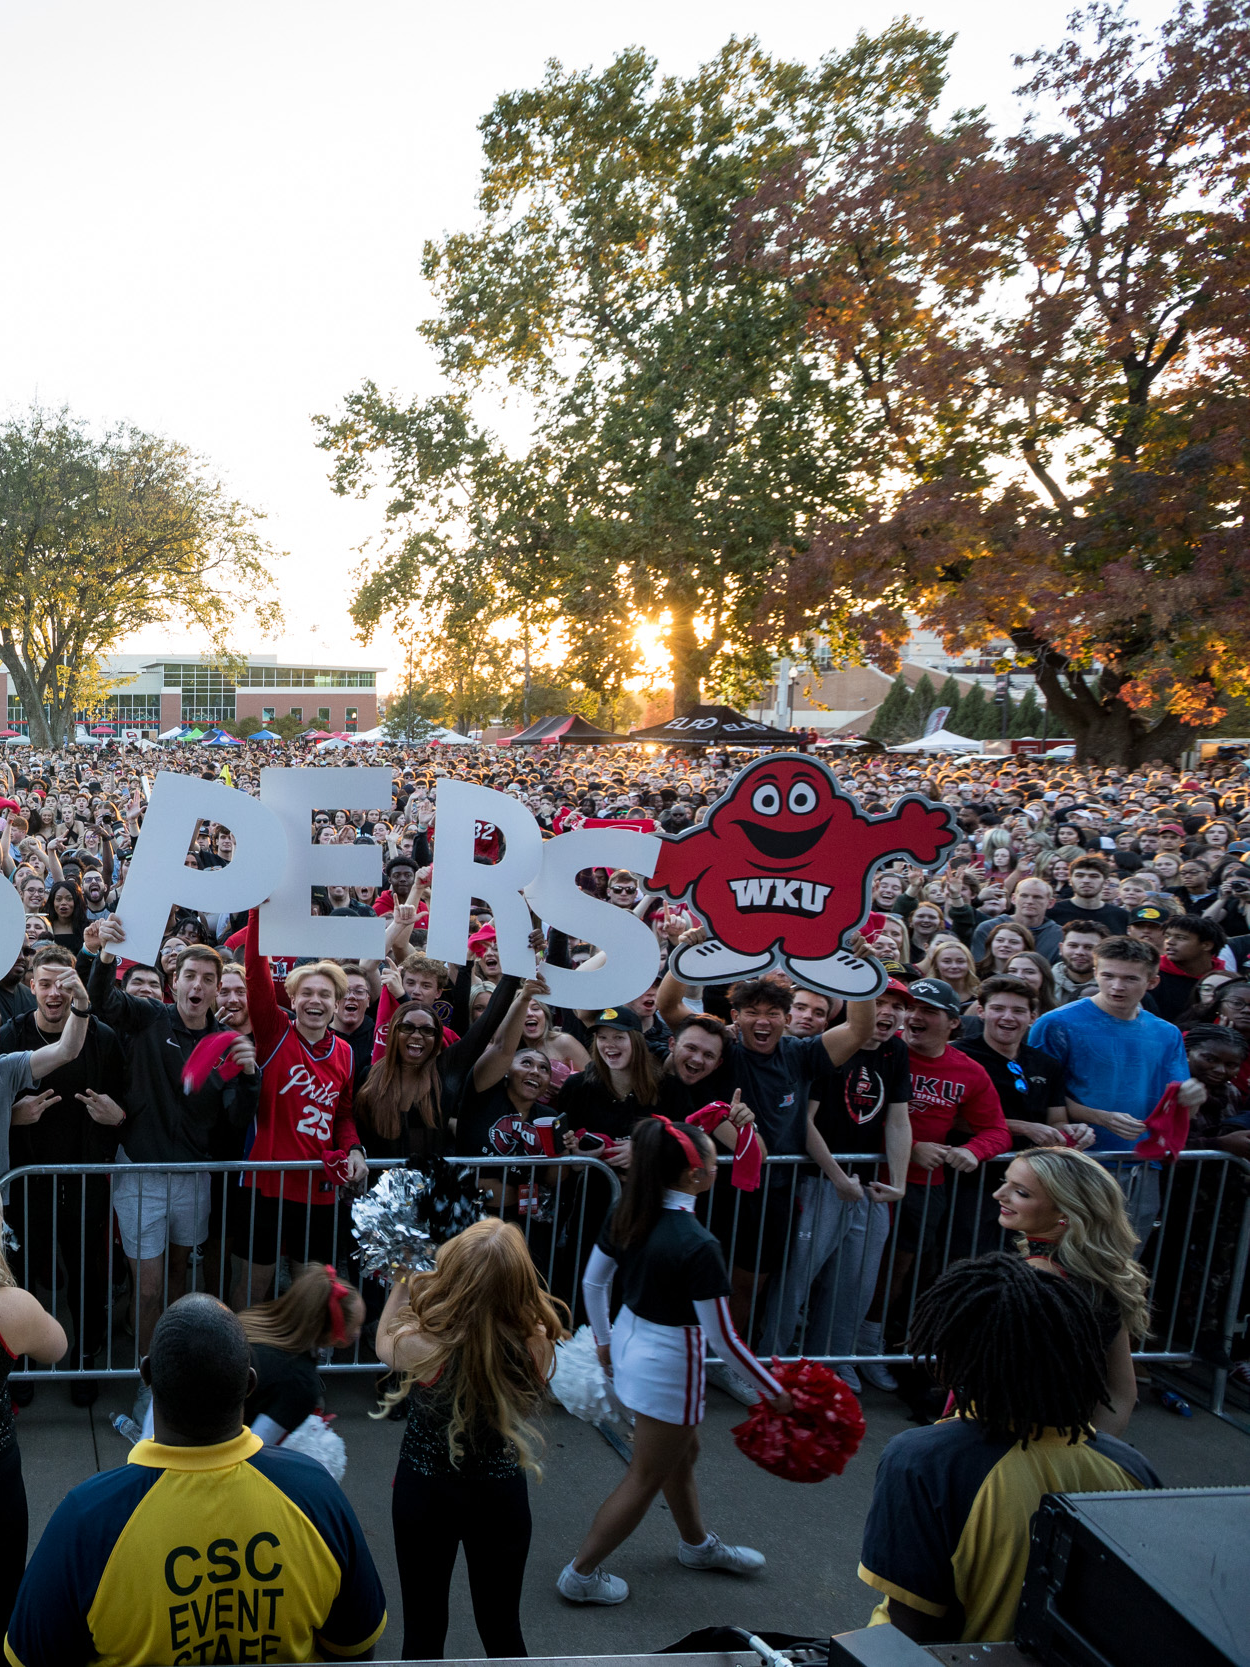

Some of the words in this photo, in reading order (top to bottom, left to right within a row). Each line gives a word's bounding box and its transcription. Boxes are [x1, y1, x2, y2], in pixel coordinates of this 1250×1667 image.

[664, 717, 718, 730] ELPO
[722, 721, 768, 732] ELPO
[729, 878, 832, 913] WKU
[910, 1073, 965, 1104] KU
[296, 1105, 333, 1141] 25
[164, 1532, 283, 1597] CSC
[168, 1588, 284, 1651] EVENT
